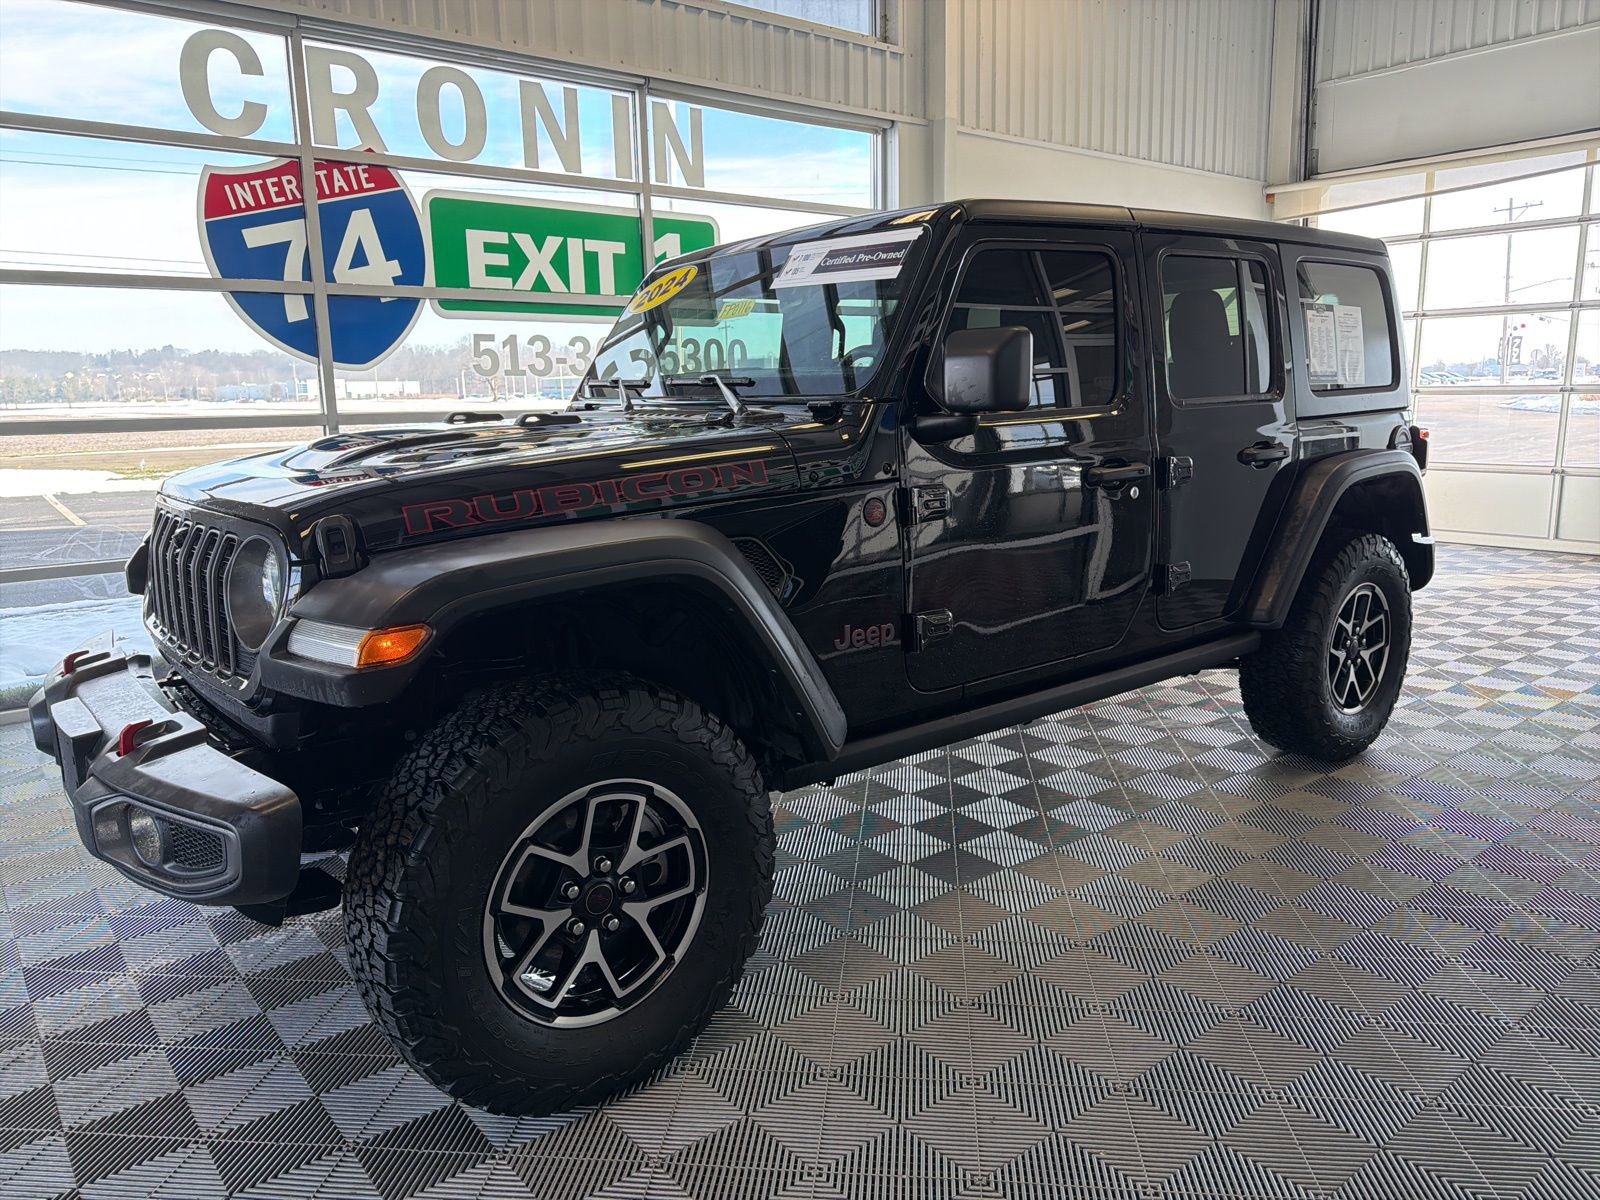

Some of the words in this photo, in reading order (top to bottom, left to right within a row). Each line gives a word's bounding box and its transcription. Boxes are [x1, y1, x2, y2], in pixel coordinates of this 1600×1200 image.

[179, 28, 705, 188] CRONIN
[223, 164, 376, 210] INTERTATE
[241, 207, 402, 322] 74
[465, 227, 626, 296] EXIT
[820, 253, 856, 267] Certified
[856, 248, 906, 263] Pre-Owned
[633, 268, 692, 310] 2024
[401, 459, 769, 536] RUBICON
[833, 622, 896, 651] Jeep
